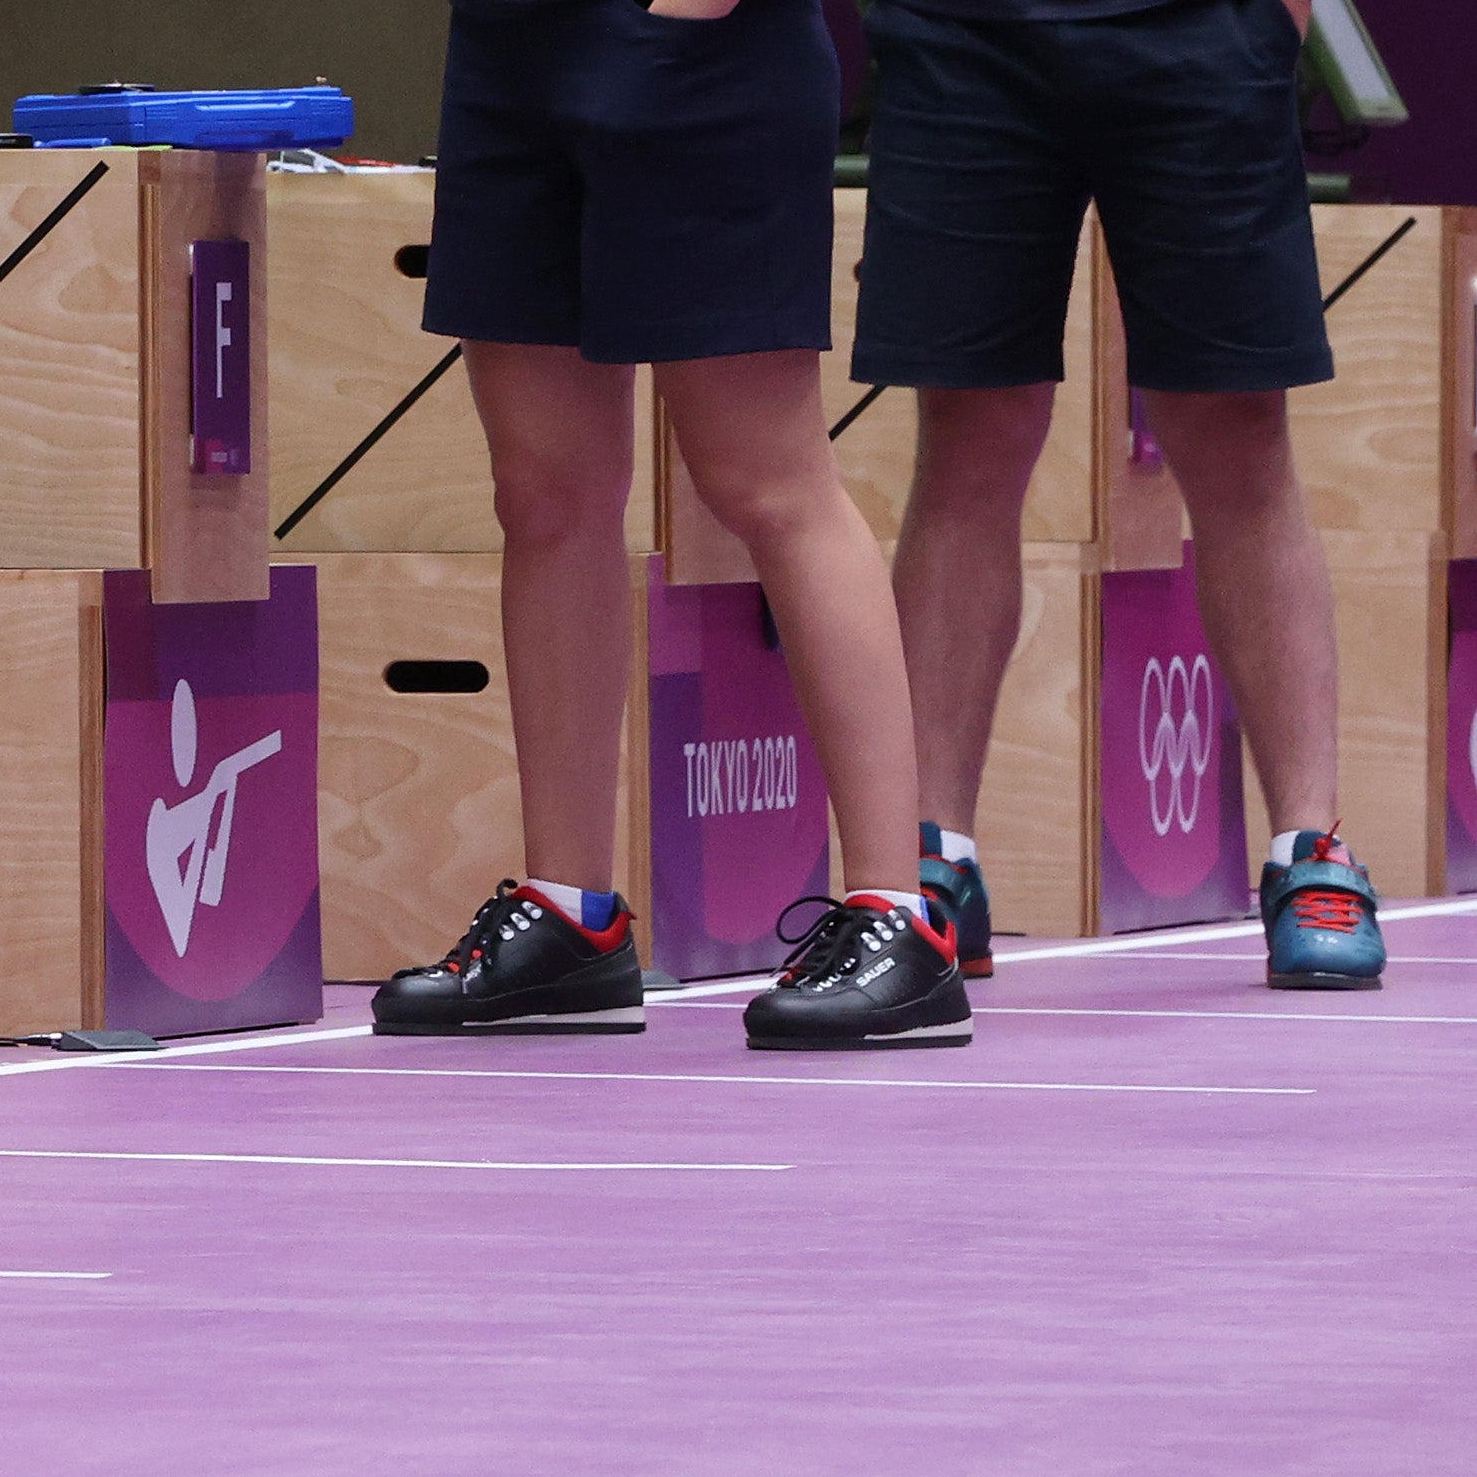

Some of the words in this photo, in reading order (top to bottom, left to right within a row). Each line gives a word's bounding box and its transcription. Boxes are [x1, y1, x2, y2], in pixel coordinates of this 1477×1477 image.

[216, 282, 232, 398] F
[683, 739, 747, 817] TOKYO
[752, 735, 797, 811] 2020
[856, 957, 896, 987] SAUER
